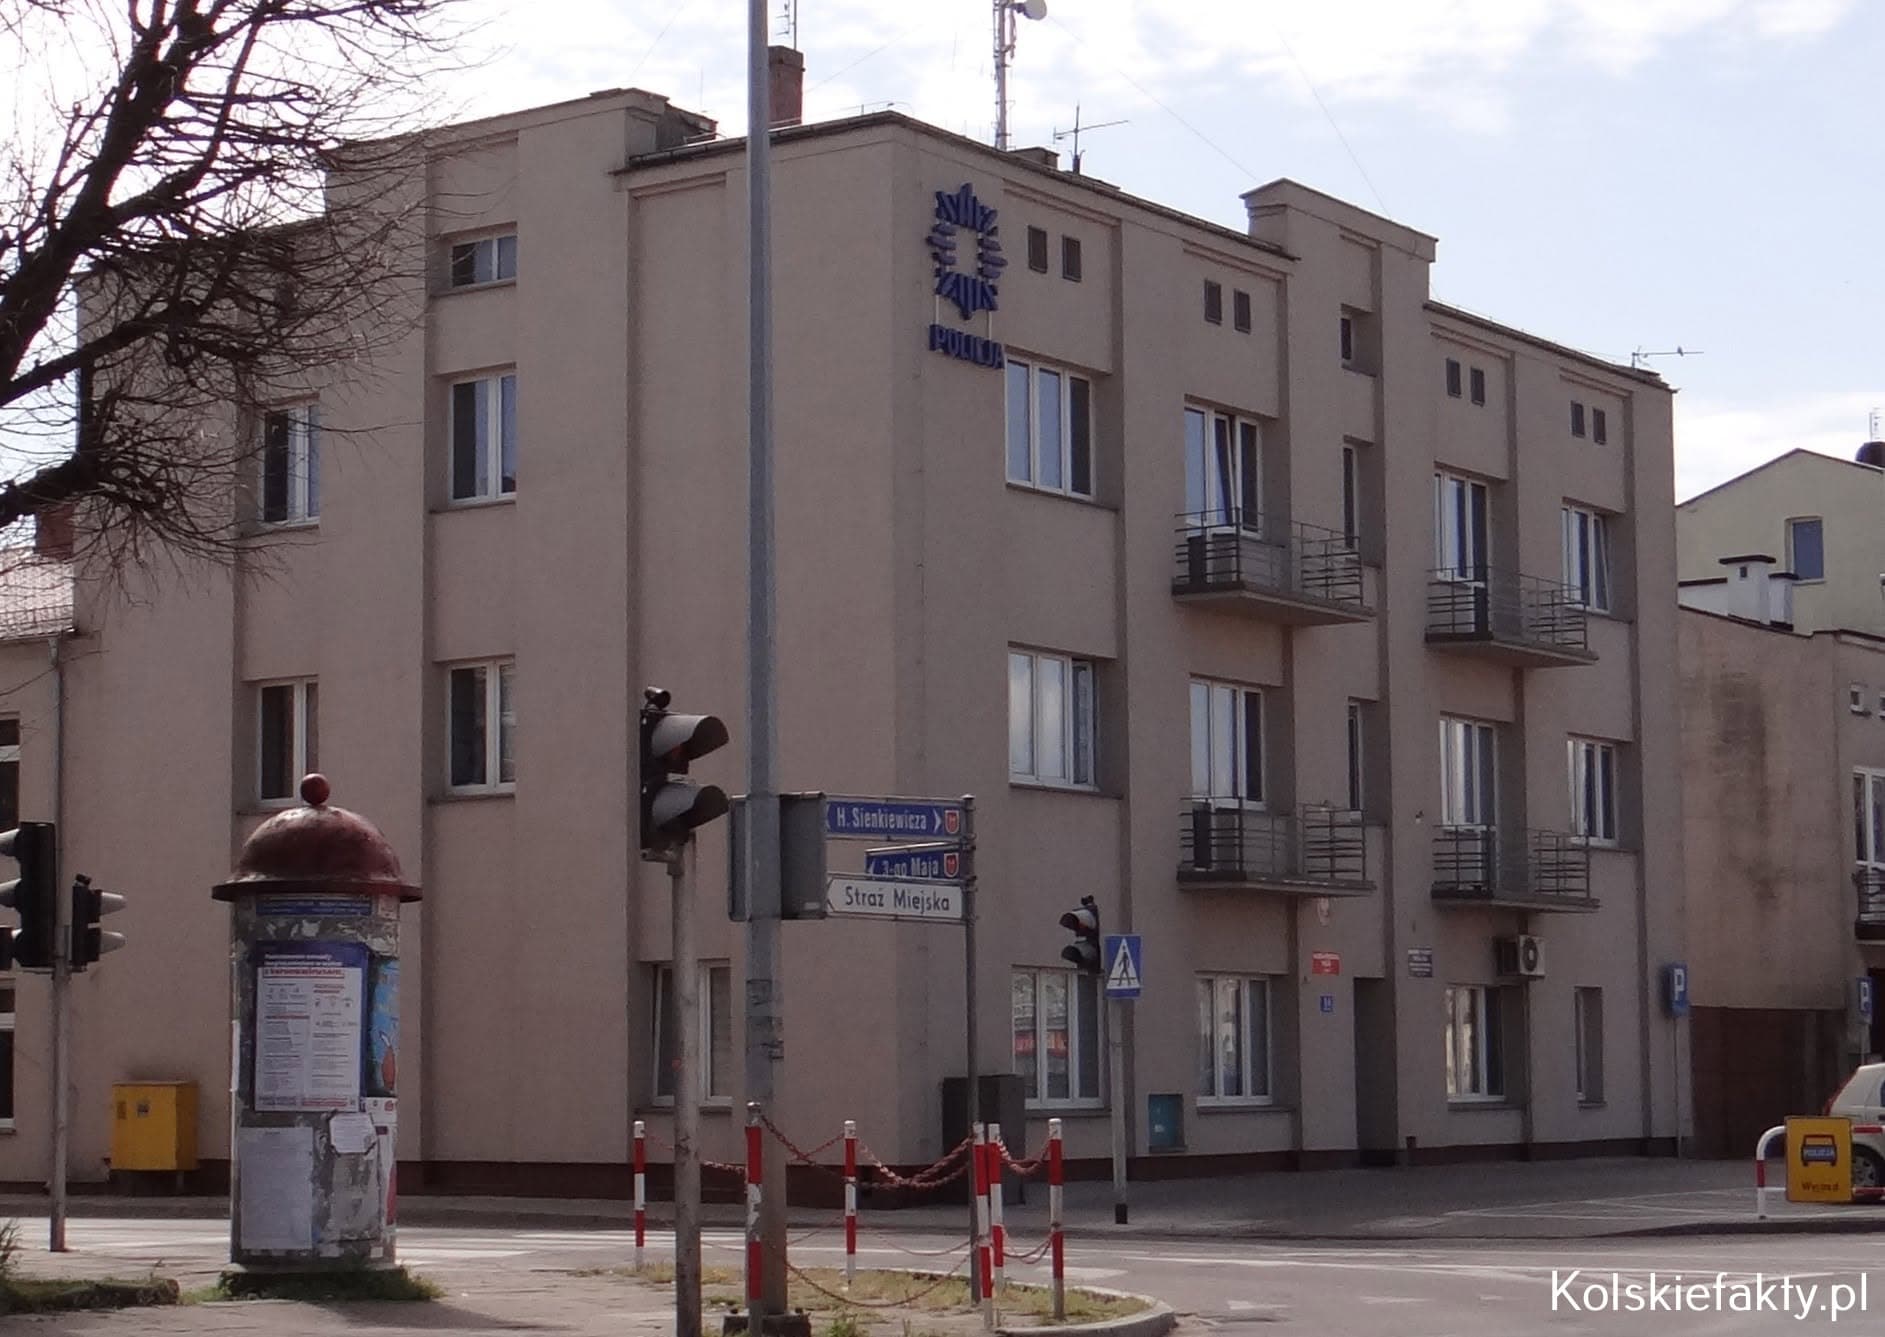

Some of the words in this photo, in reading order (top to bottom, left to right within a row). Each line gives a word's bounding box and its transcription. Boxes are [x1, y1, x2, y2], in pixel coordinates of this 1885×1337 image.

[837, 808, 850, 827] H.
[852, 808, 927, 830] Sienkiewicza
[911, 858, 939, 876] Maja
[845, 886, 885, 908] Straż
[893, 888, 950, 914] Miejska
[1673, 968, 1685, 1000] P
[1860, 981, 1869, 1011] P
